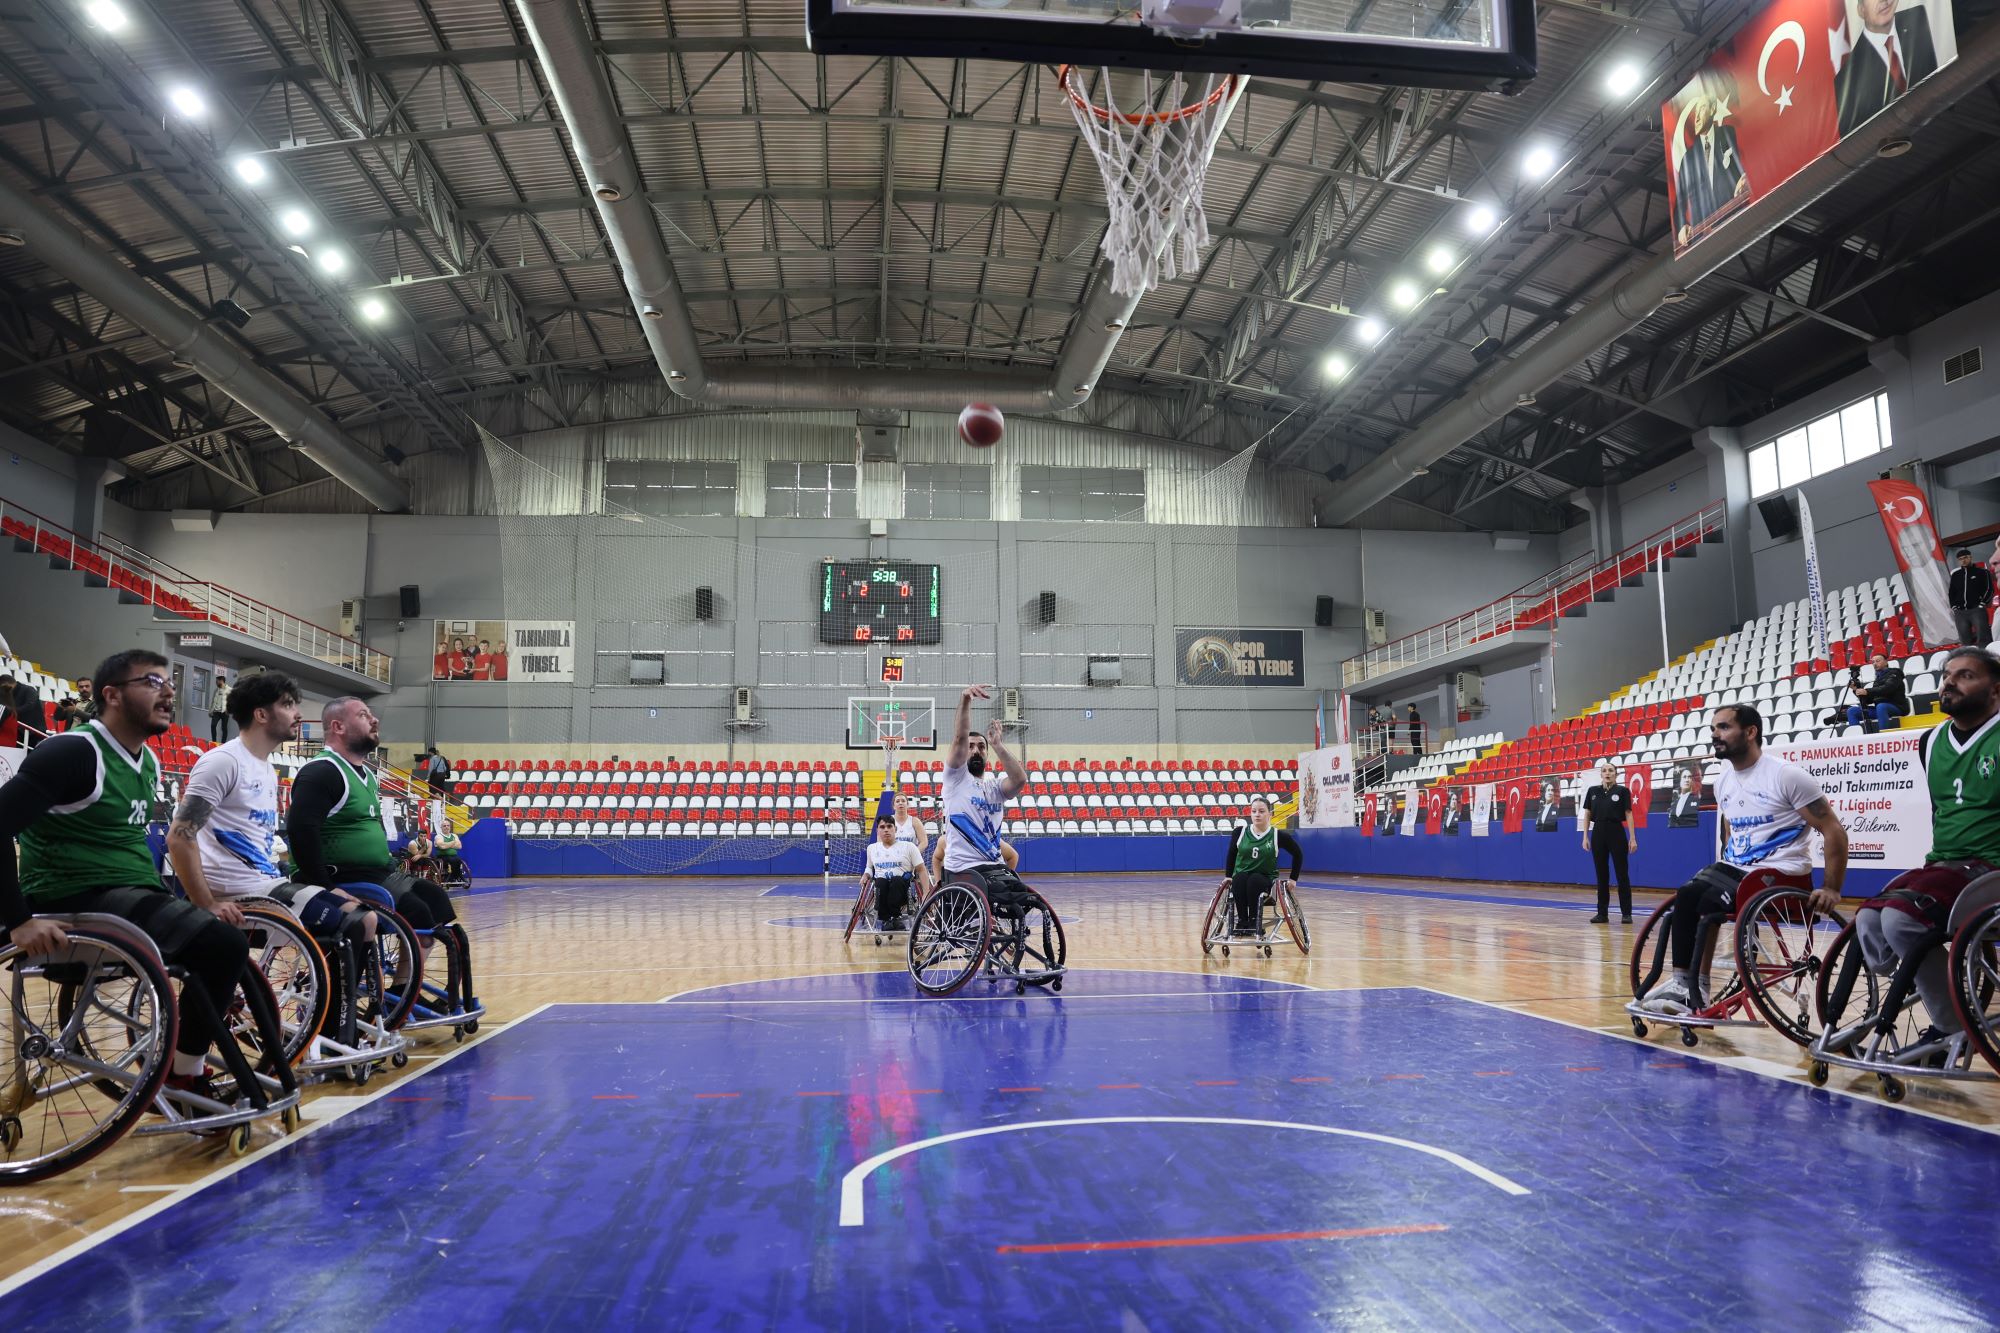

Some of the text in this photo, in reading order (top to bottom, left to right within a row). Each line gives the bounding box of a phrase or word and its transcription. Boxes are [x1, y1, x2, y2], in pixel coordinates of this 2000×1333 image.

[873, 570, 897, 582] 5:38
[860, 585, 868, 596] 2
[901, 585, 909, 597] 0
[855, 627, 870, 640] 02
[898, 629, 913, 640] 04
[1232, 641, 1265, 658] SPOR
[886, 658, 903, 667] 5:38
[1258, 660, 1294, 676] YERDE
[883, 667, 900, 681] 24
[1801, 744, 1864, 761] PAMUKKALE
[1867, 737, 1920, 756] BELEDİYE
[1801, 758, 1909, 777] kerlekli Sandalye
[1845, 779, 1914, 793] Takımımıza
[127, 799, 148, 825] 26
[1839, 797, 1892, 813] 1.Liginde
[1852, 816, 1900, 832] Dilerim.
[1252, 846, 1260, 859] 6
[1855, 842, 1884, 851] Ertemur
